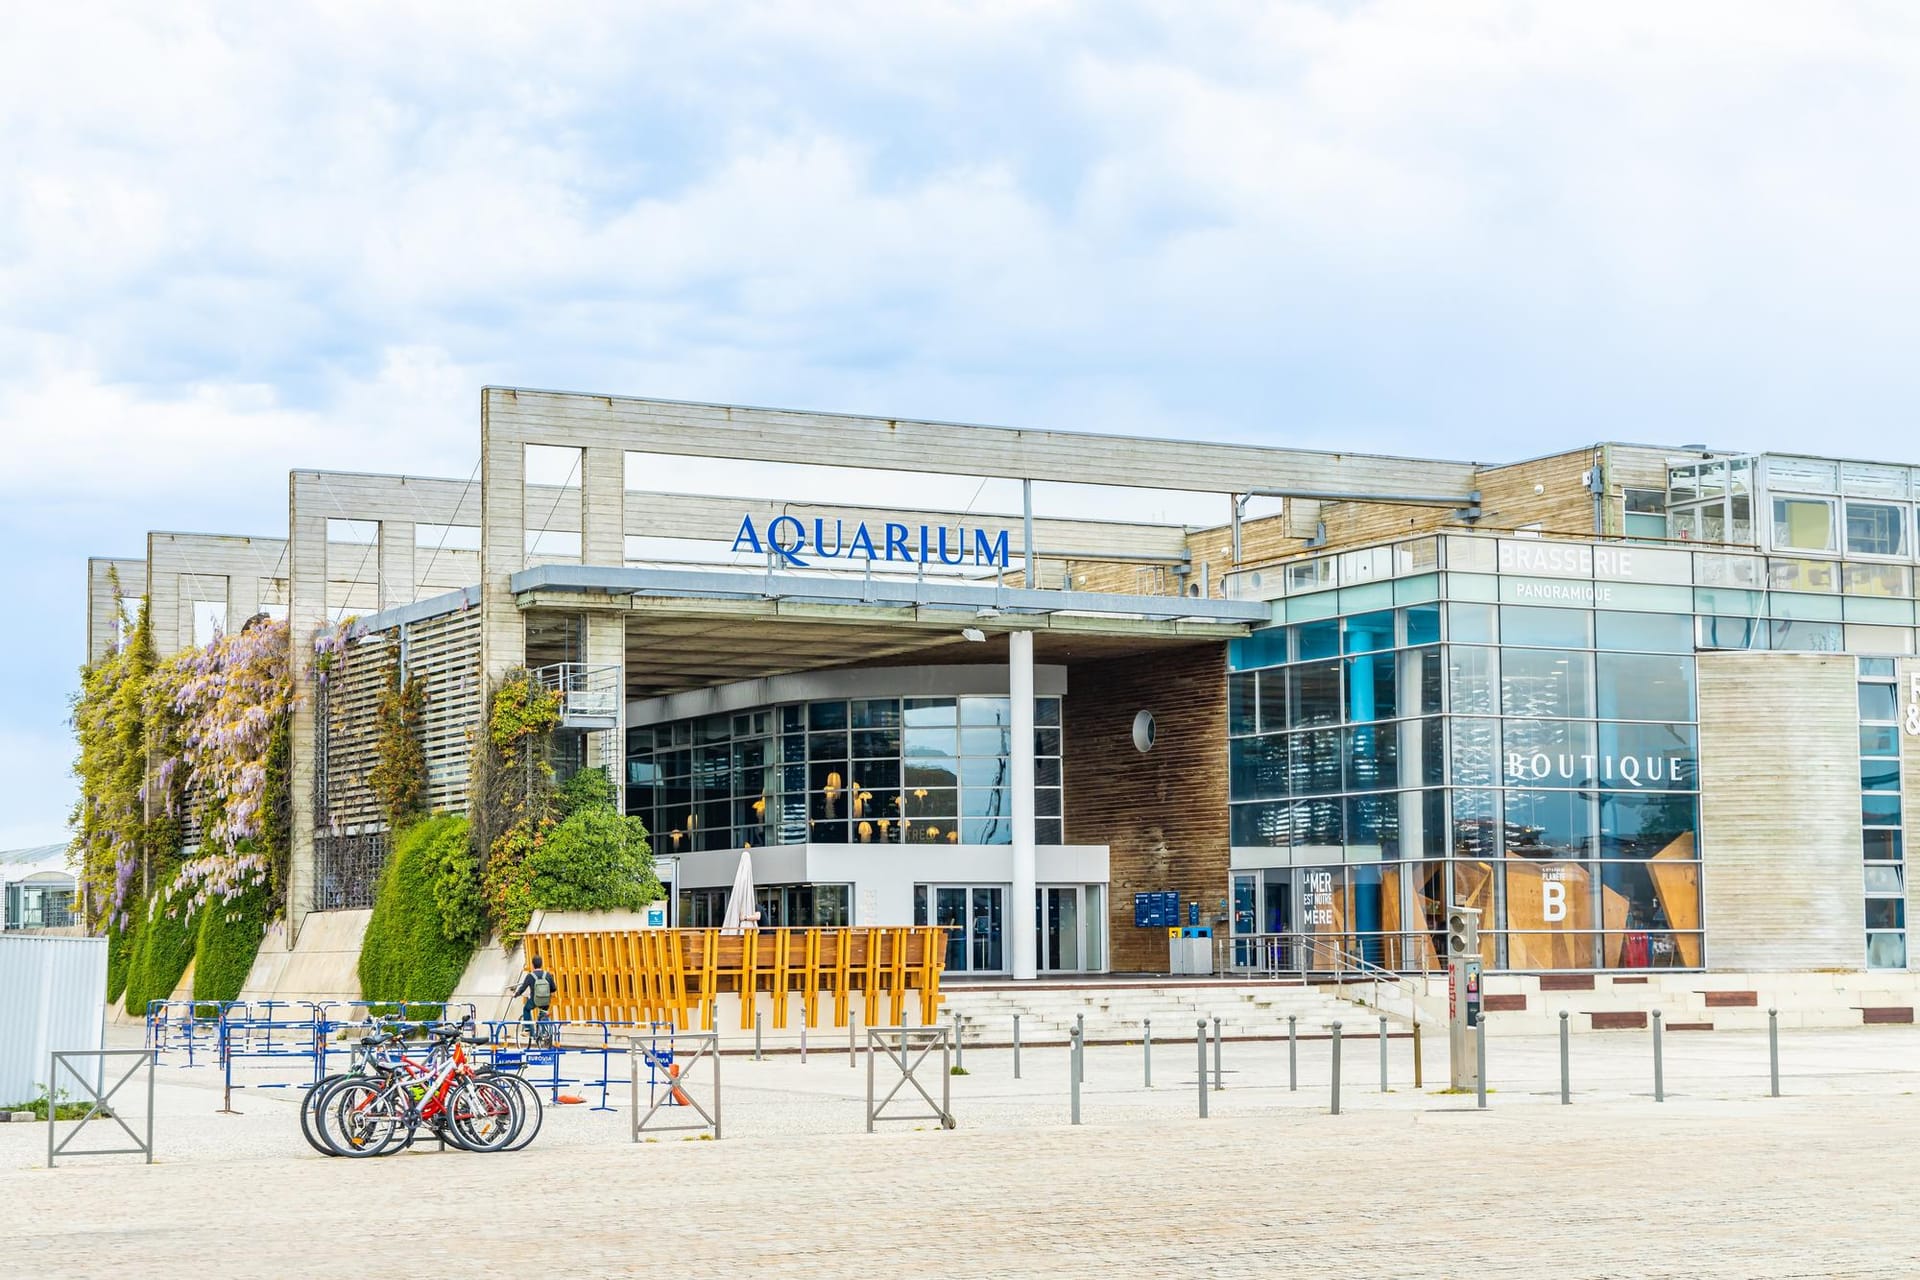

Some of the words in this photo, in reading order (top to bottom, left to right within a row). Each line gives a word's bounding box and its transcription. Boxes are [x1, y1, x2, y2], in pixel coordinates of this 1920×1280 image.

[731, 512, 1009, 567] AQUARIUM
[1500, 544, 1633, 576] BRASSERIE
[1516, 583, 1612, 602] PANORAMIQUE
[1508, 752, 1684, 787] BOUTIQUE
[1310, 872, 1332, 893] MER
[1303, 893, 1313, 906] EST
[1543, 881, 1567, 922] B
[1303, 905, 1333, 925] MÈRE
